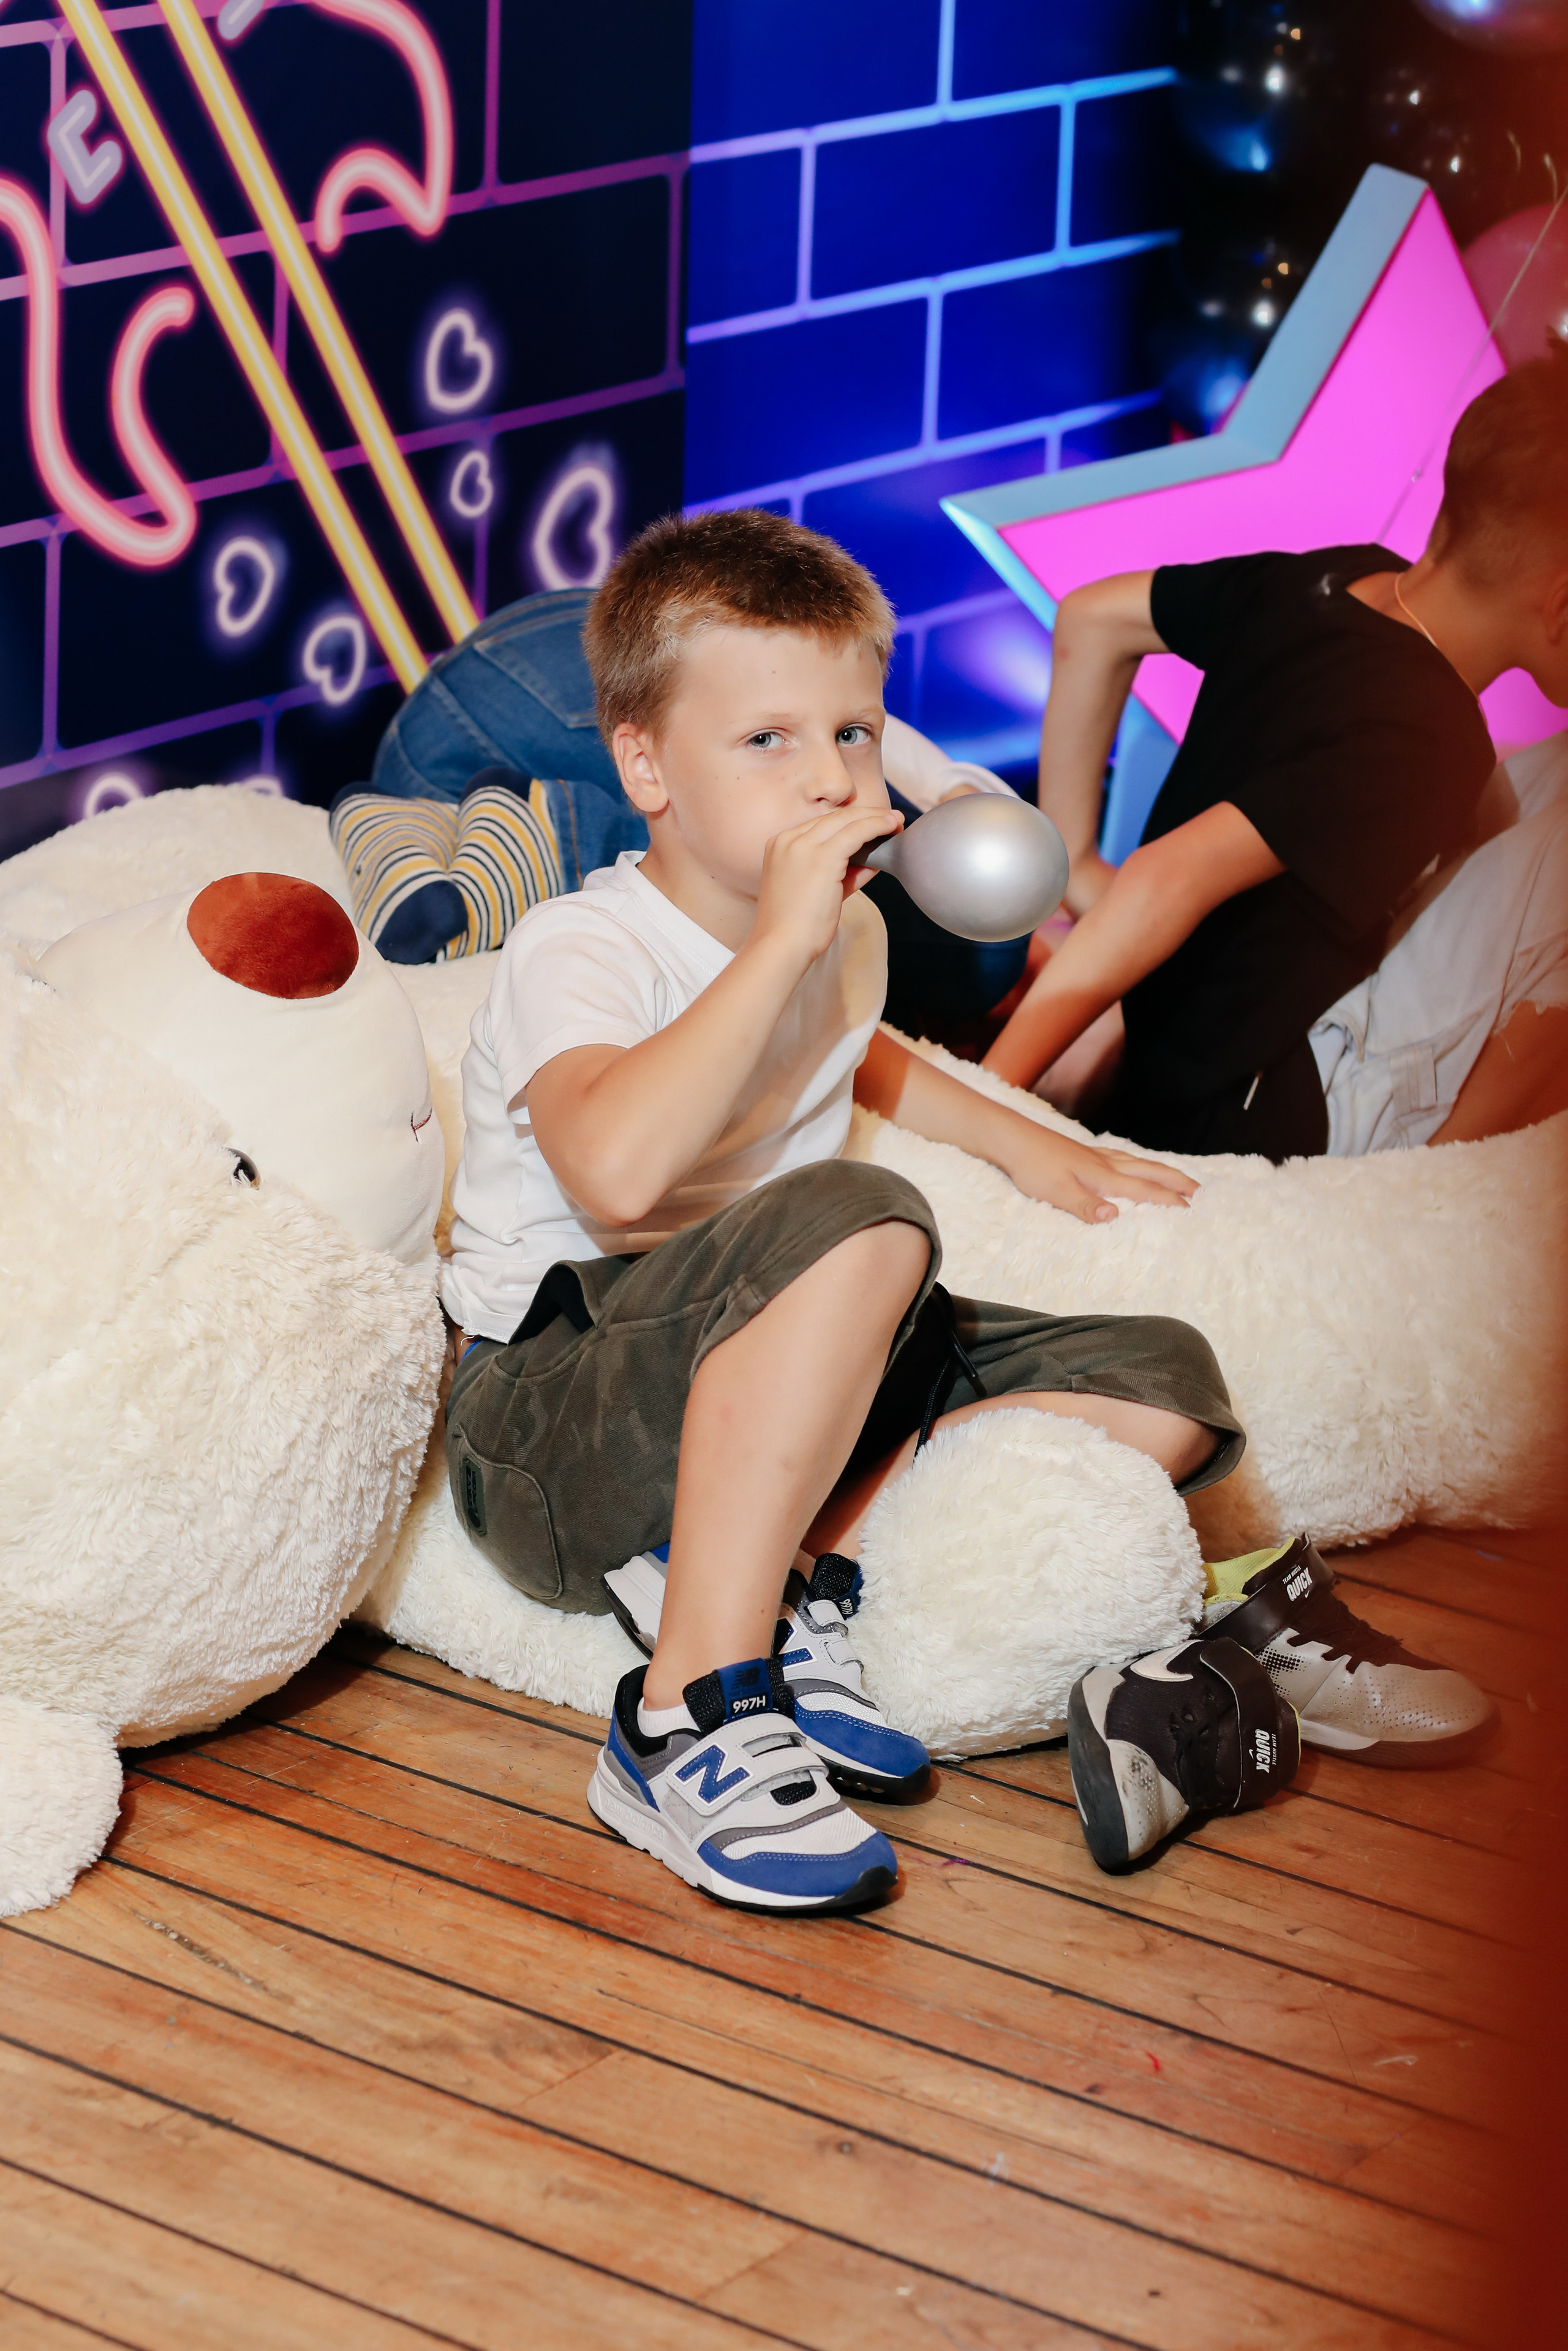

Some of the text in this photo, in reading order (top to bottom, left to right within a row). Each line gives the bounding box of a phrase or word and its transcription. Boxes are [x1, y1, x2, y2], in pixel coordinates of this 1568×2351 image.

[1283, 1565, 1302, 1584] TEAM HUSTLE
[1286, 1567, 1313, 1601] QUICK
[839, 1598, 853, 1615] 997H
[733, 1695, 766, 1713] 997H
[1254, 1729, 1271, 1773] QUICK
[674, 1744, 751, 1804] N
[603, 1798, 665, 1841] new balance
